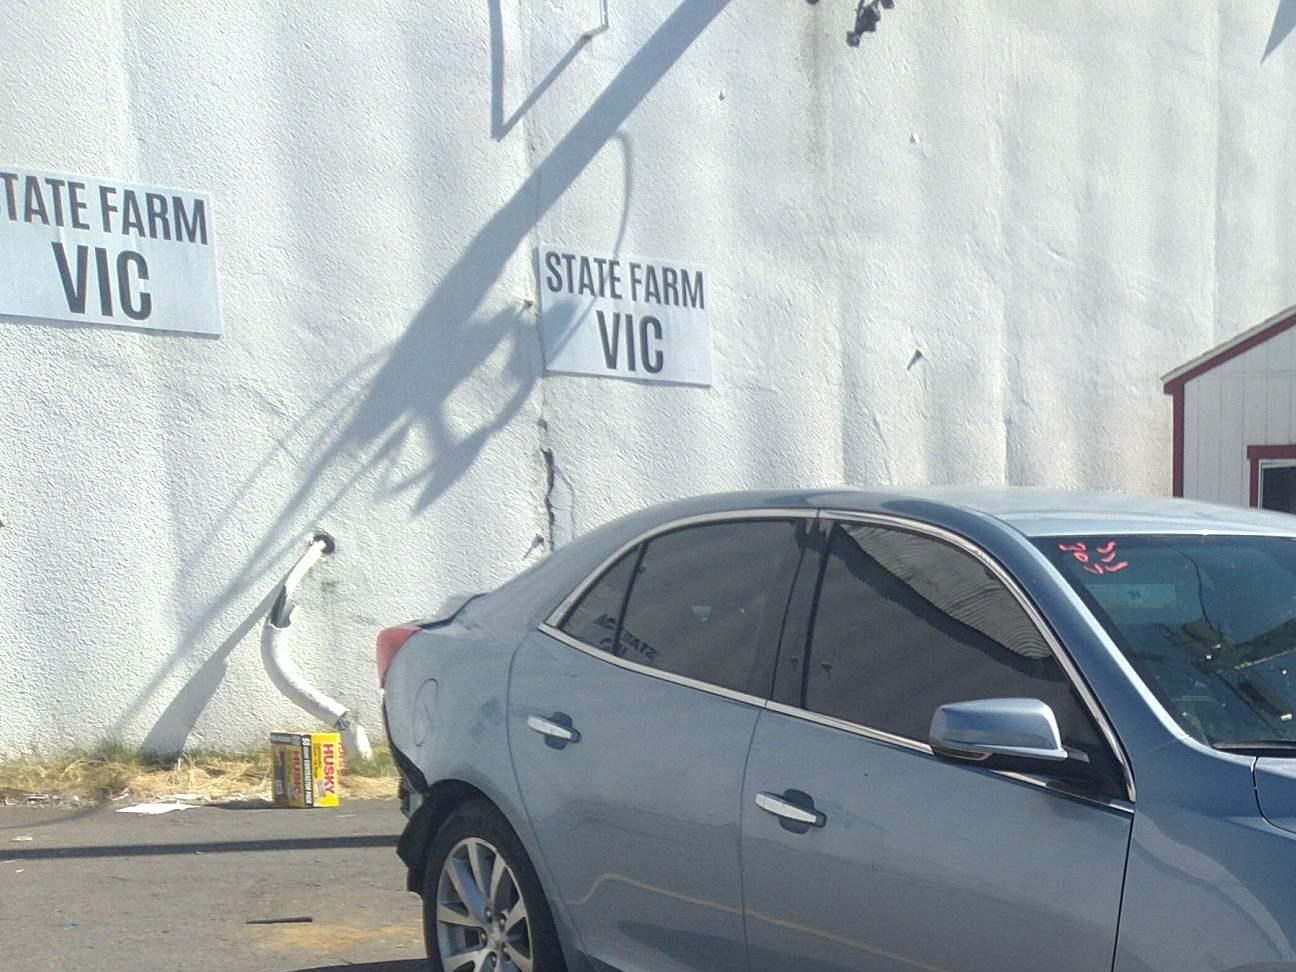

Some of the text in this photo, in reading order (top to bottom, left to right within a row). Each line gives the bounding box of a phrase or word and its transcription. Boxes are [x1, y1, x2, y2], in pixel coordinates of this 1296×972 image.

[99, 185, 208, 245] FARM
[51, 241, 152, 320] VIC
[545, 251, 704, 309] STATE FARM
[595, 310, 664, 374] VIC
[323, 743, 334, 794] HUSKY
